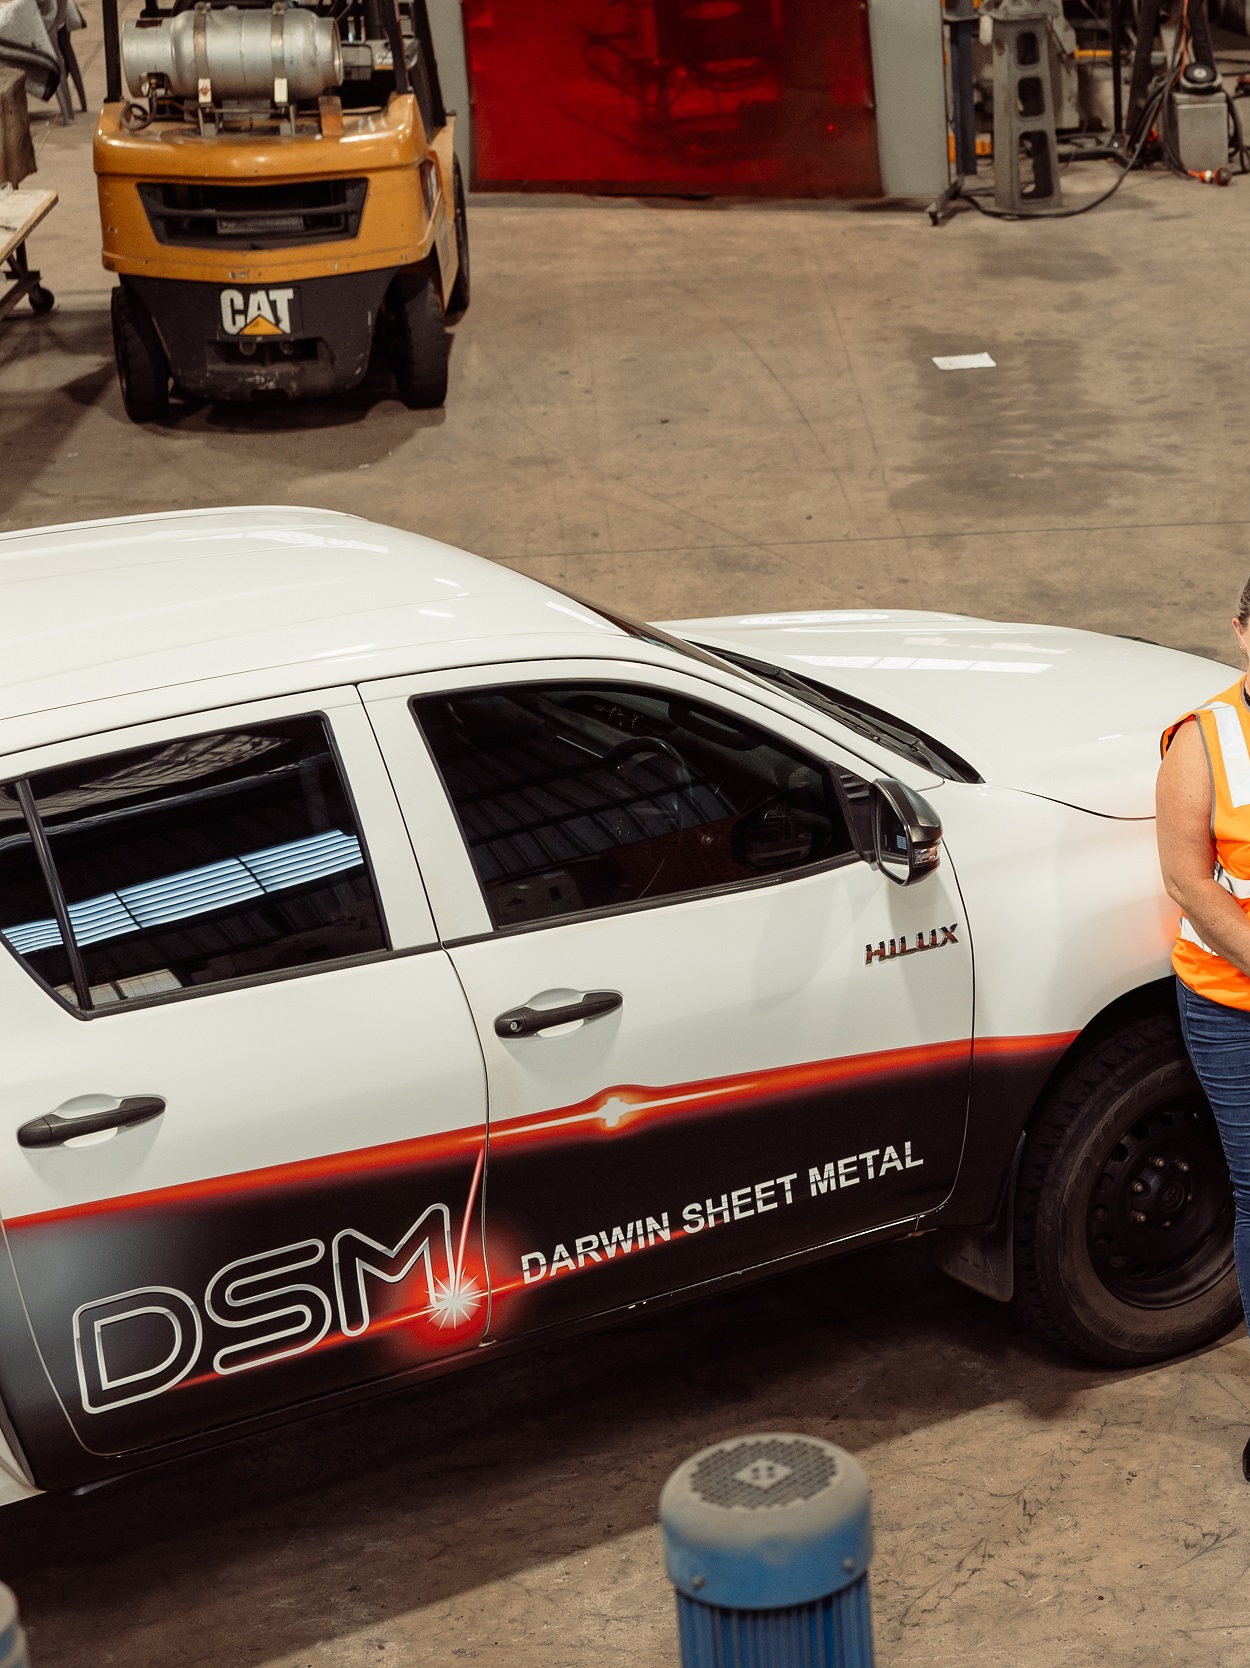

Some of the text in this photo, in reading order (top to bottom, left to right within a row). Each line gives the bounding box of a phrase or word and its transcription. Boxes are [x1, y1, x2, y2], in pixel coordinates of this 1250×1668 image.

[220, 288, 294, 335] CAT
[865, 923, 959, 965] HILUX
[520, 1141, 924, 1284] DARWIN SHEET METAL
[73, 1203, 455, 1414] DSM
